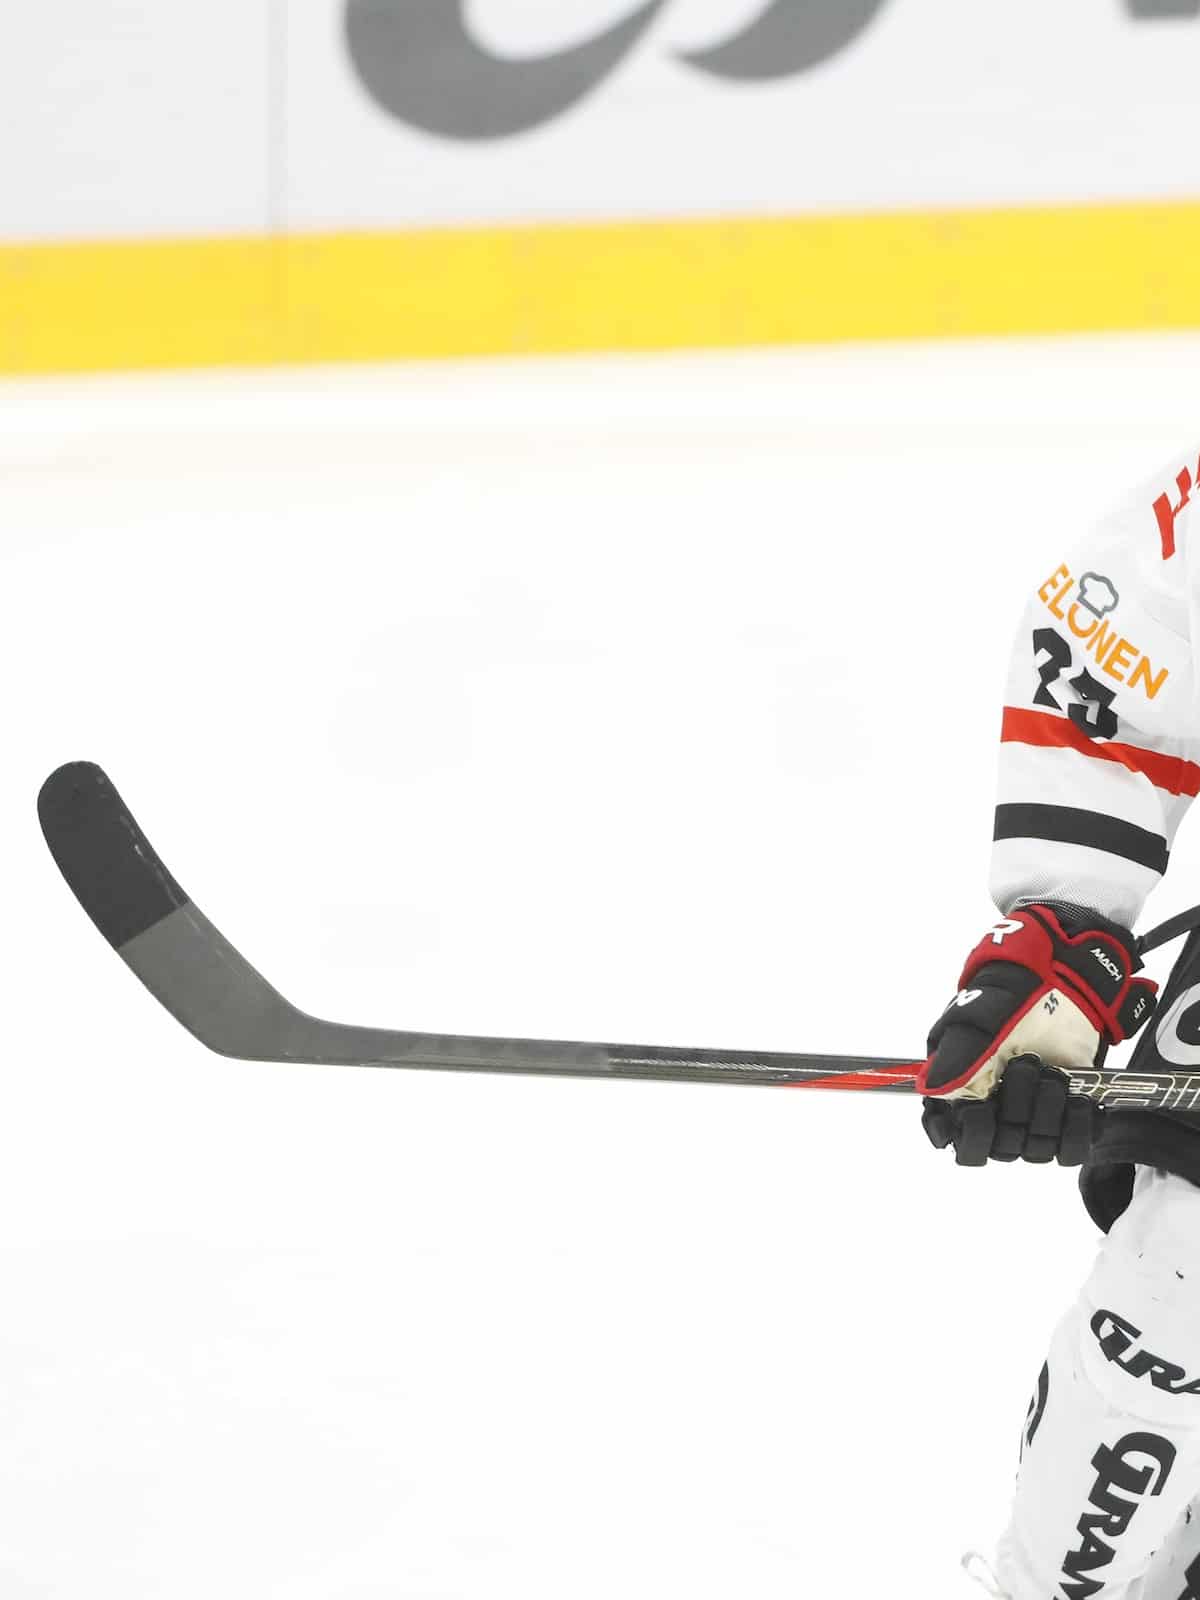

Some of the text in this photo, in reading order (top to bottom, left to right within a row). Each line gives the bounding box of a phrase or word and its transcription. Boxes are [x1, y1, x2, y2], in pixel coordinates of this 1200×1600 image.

[1033, 627, 1119, 740] 25
[1037, 562, 1169, 700] ELONEN
[1090, 948, 1124, 981] MACH
